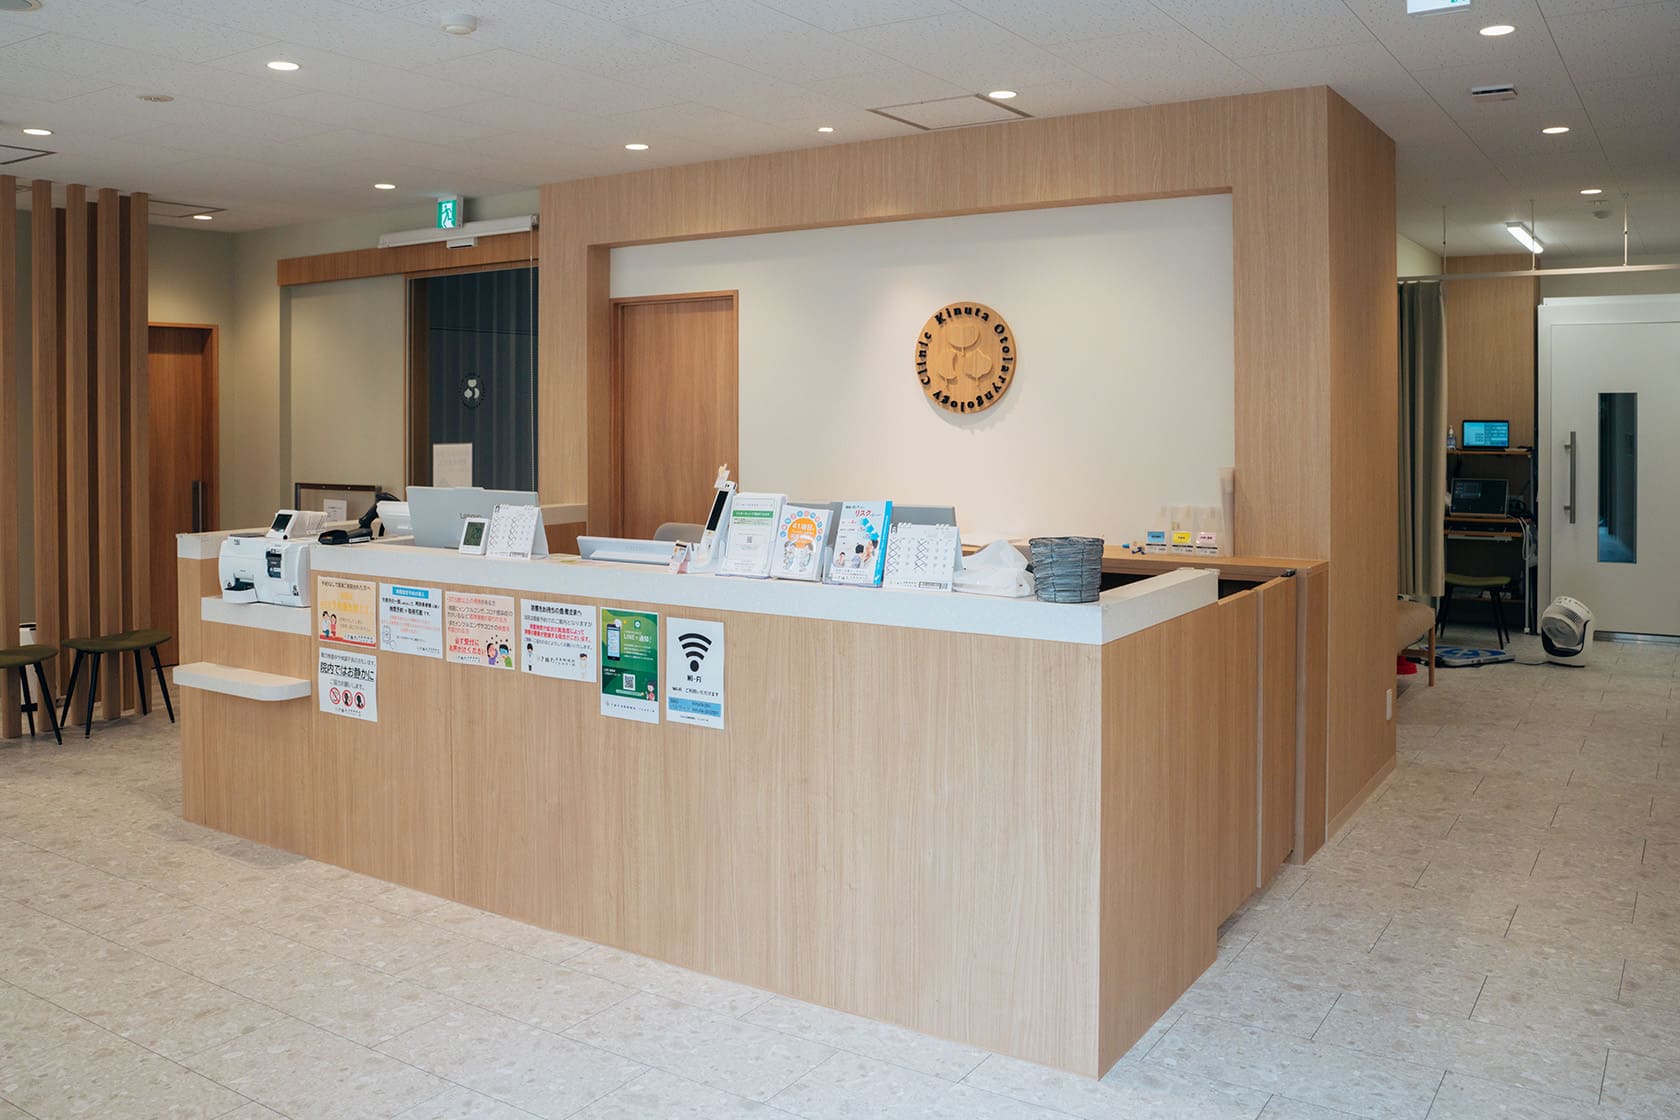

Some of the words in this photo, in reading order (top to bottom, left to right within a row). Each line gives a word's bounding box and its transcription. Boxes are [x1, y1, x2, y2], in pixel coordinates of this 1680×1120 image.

[934, 306, 990, 325] Kinuta
[916, 331, 932, 386] Clinic
[933, 323, 1014, 413] Otolaryngology
[855, 509, 872, 518] リスク
[320, 661, 375, 682] 院内ではお静かに
[687, 675, 702, 683] Wi-Fi
